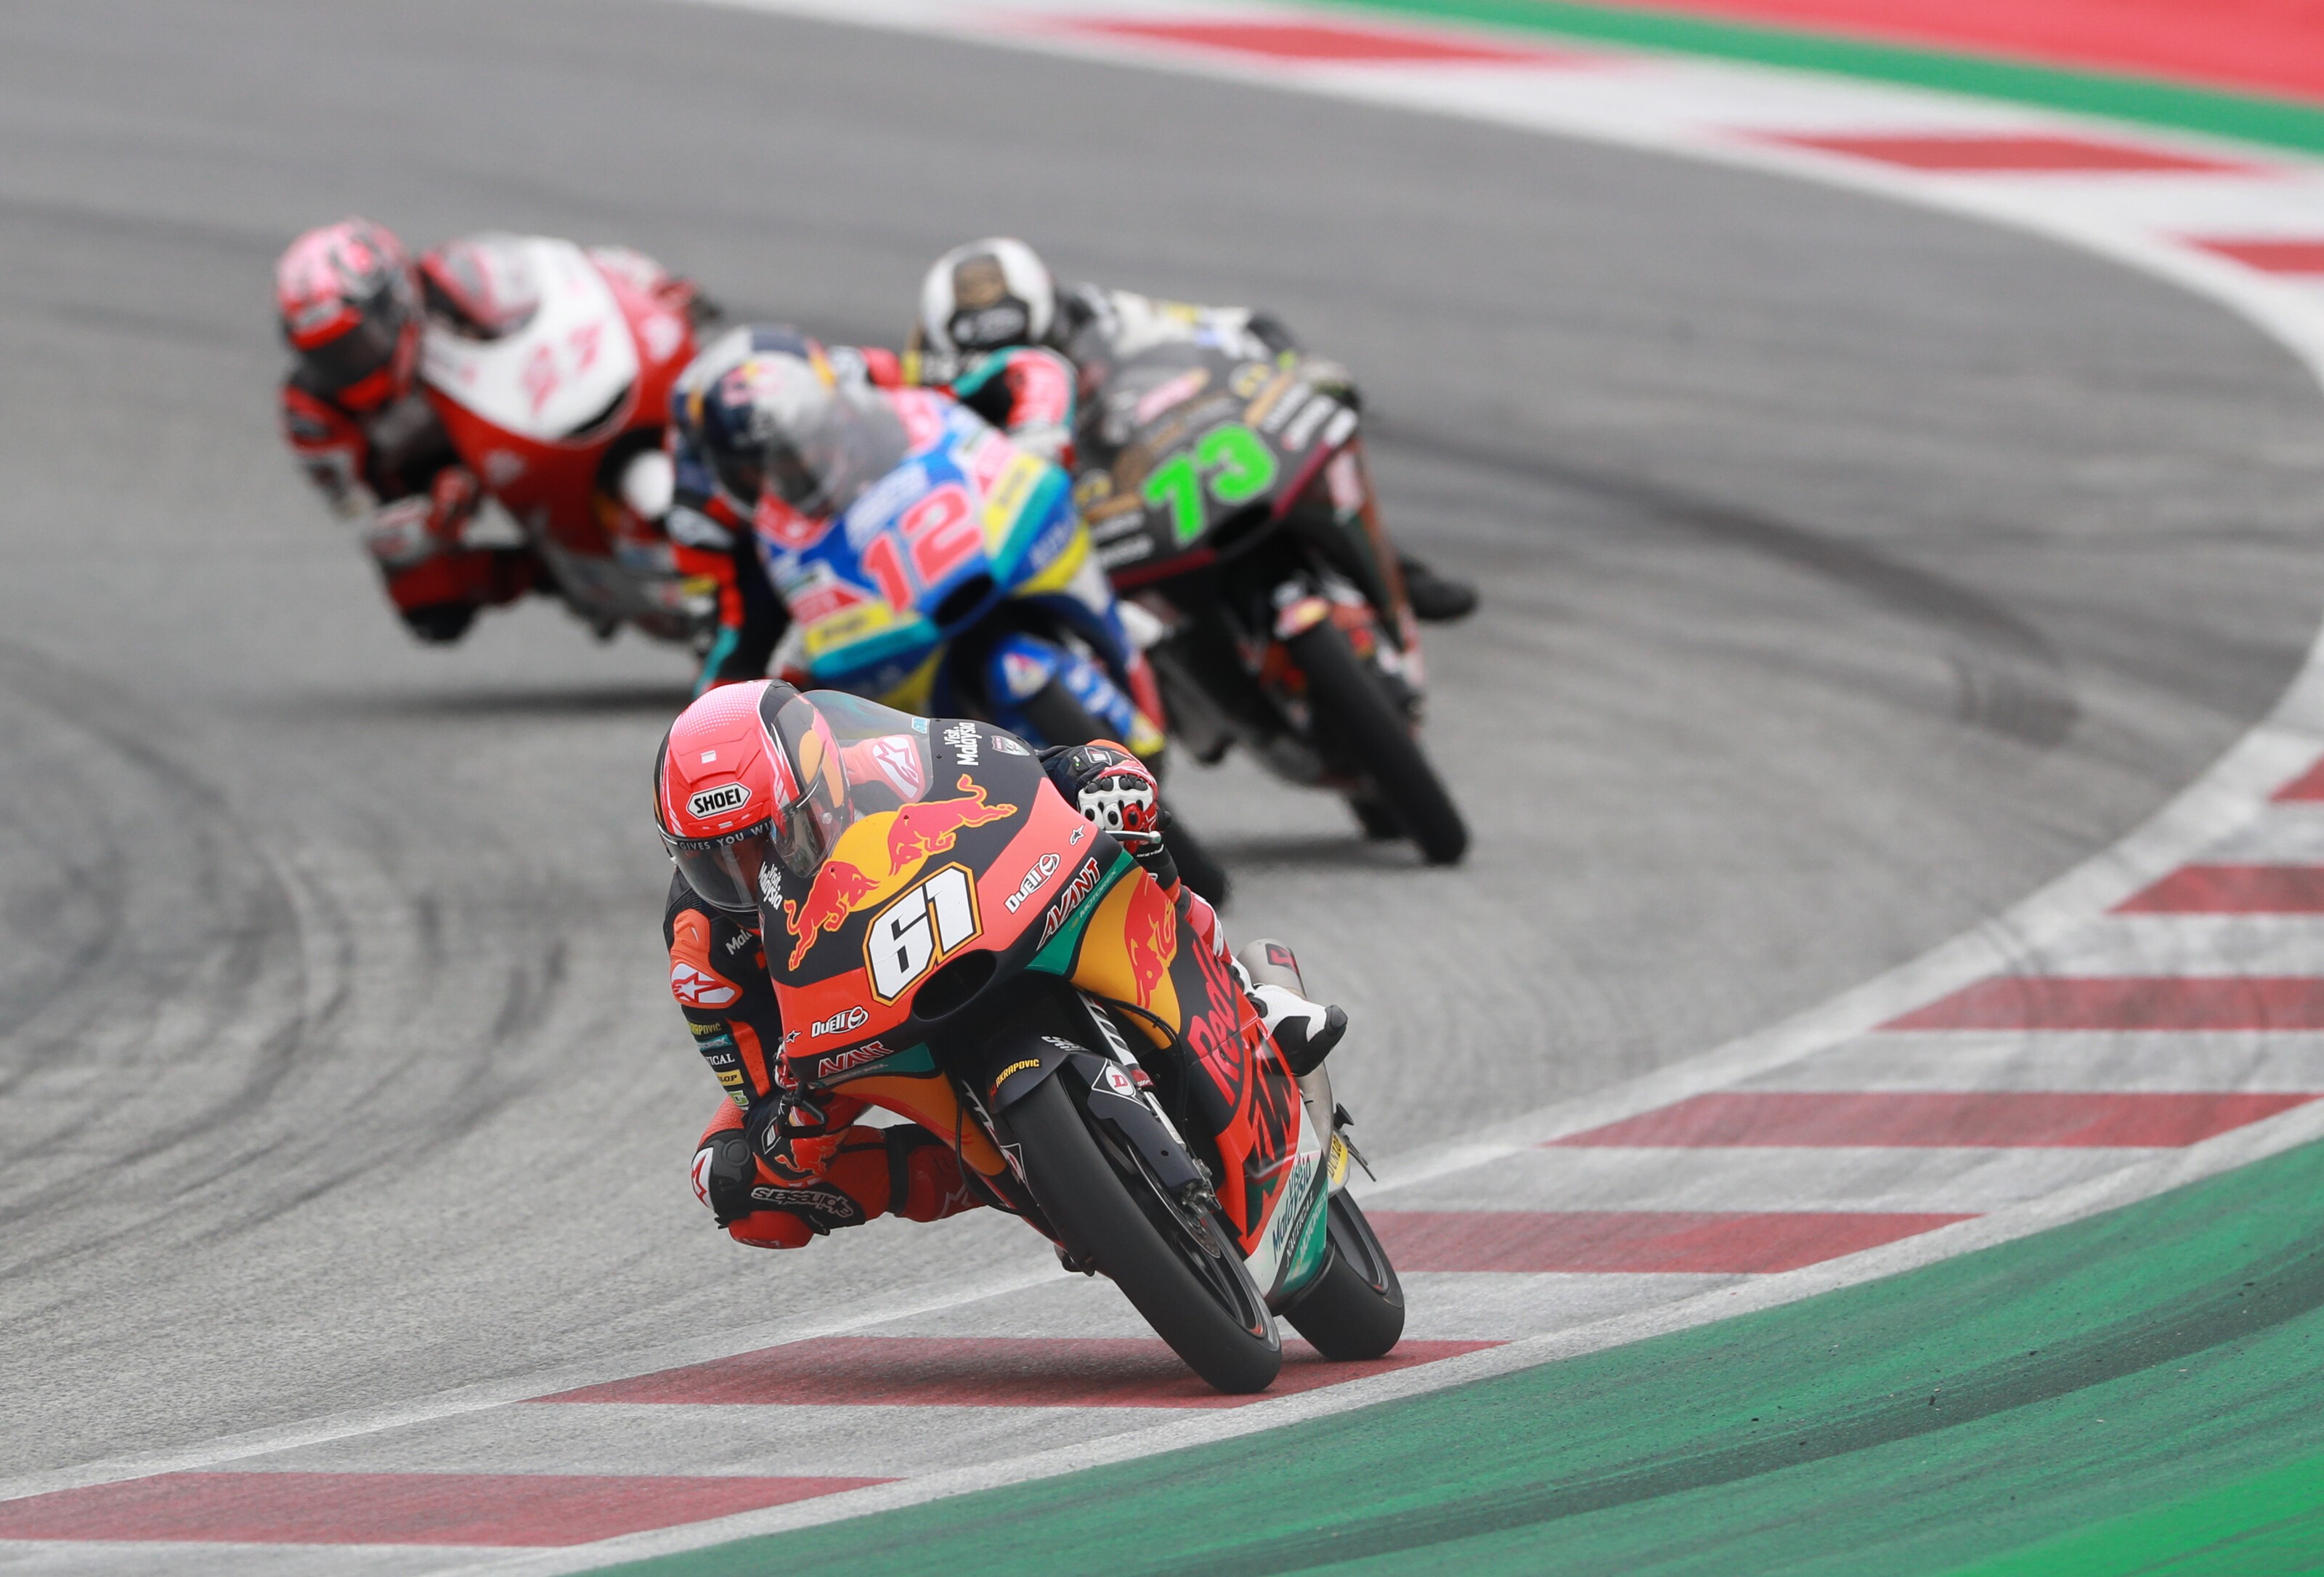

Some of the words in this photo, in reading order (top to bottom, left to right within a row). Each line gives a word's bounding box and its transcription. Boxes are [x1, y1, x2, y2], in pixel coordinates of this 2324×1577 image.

[1143, 421, 1277, 546] 73
[861, 483, 983, 614] 12
[943, 729, 960, 745] Visit
[954, 722, 982, 766] Malaysia
[694, 787, 742, 814] SHOEI
[680, 842, 710, 851] GIVES
[717, 832, 744, 847] YOU
[1036, 857, 1100, 952] AVANT
[1079, 868, 1117, 918] MOTOREX
[866, 865, 977, 1002] 61
[818, 1041, 894, 1078] AVANT
[996, 1058, 1040, 1088] AKRAPOVIC
[1112, 1074, 1129, 1088] D
